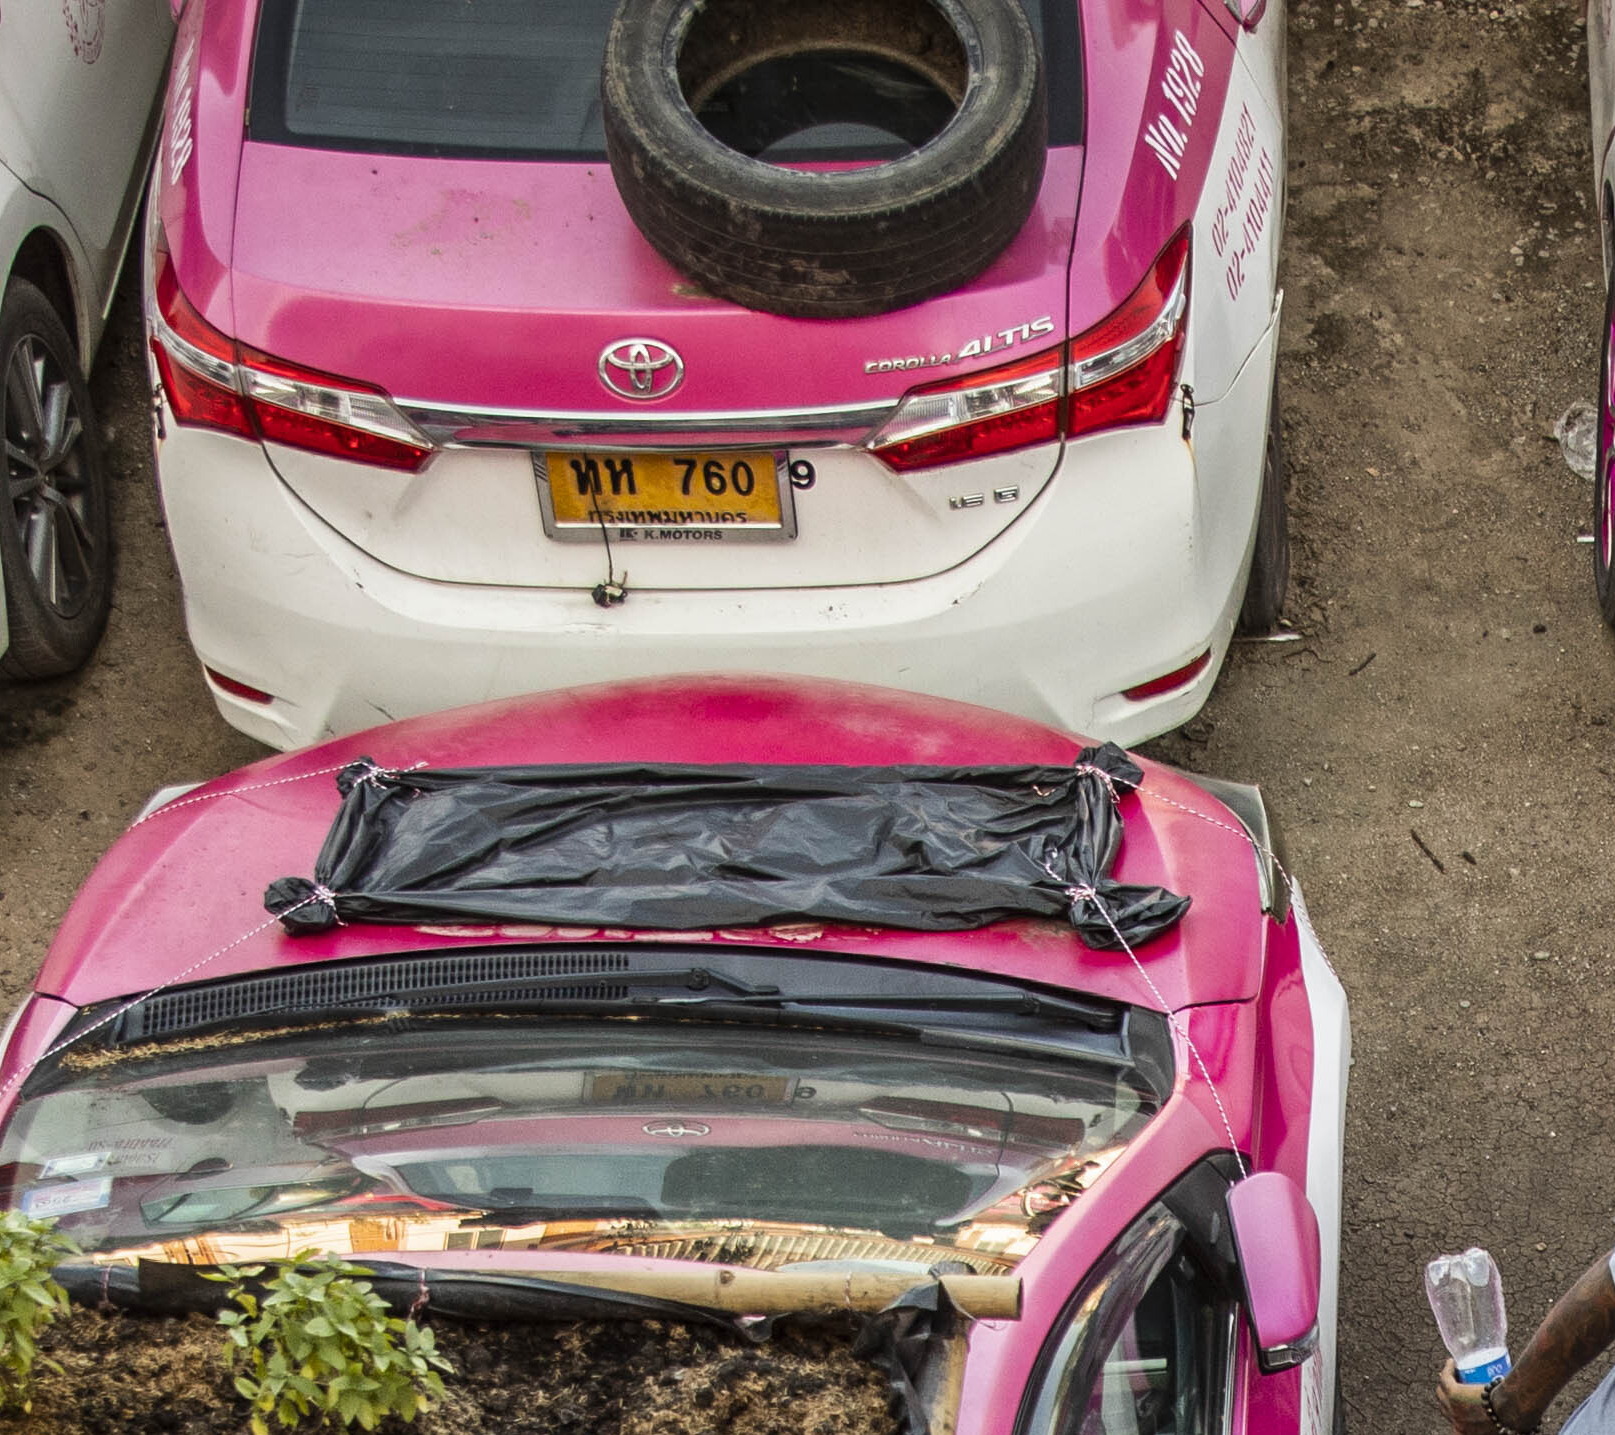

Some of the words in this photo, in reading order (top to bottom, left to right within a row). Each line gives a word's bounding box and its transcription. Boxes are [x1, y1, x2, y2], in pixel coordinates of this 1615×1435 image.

[1162, 29, 1205, 127] 1928
[1144, 113, 1188, 181] No.
[1212, 101, 1256, 258] 02-4104821
[1226, 147, 1274, 302] 02-4104411
[864, 354, 952, 374] COROLLA
[952, 316, 1054, 361] ALTIS
[570, 458, 636, 496] ทห
[674, 459, 755, 497] 760
[644, 528, 723, 541] K.MOTORS
